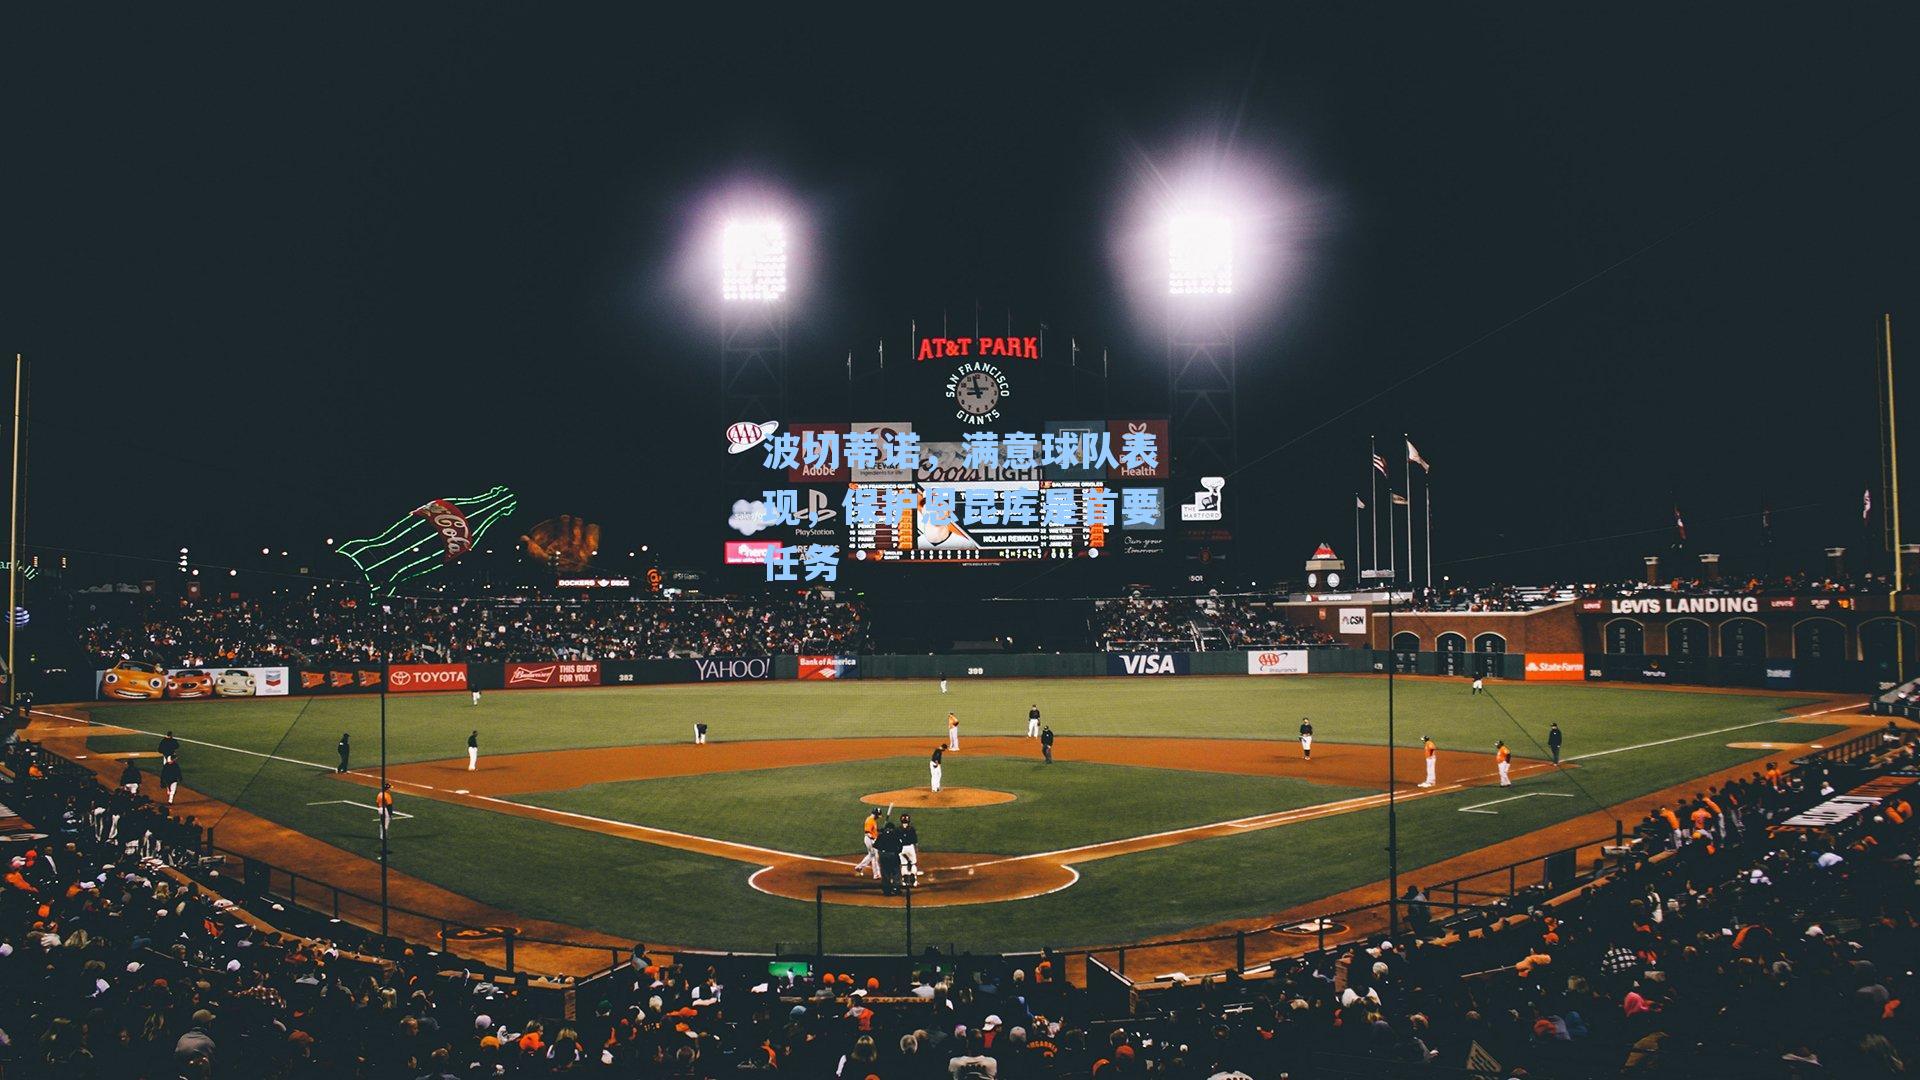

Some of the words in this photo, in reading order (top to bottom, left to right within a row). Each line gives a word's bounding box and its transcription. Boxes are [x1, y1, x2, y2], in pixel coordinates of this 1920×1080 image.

[917, 338, 973, 360] AT&T
[979, 337, 1038, 359] PARK
[945, 374, 960, 398] SAN
[958, 361, 1010, 397] FRANCISCO
[956, 410, 1001, 425] GIANTS
[1121, 466, 1157, 476] Health
[795, 528, 835, 537] PlayStation
[983, 535, 1007, 543] NOLAN
[1008, 535, 1039, 543] REIMOLD
[1665, 597, 1759, 613] LANDING
[1350, 616, 1364, 625] CSN
[800, 657, 818, 666] Bank
[819, 657, 827, 666] of
[827, 658, 857, 666] America
[1119, 654, 1175, 674] VISA
[1538, 662, 1561, 671] State
[1562, 662, 1584, 671] Farm
[560, 665, 576, 673] THIS
[577, 664, 598, 673] BUD'S
[696, 658, 771, 681] YAHOO!
[413, 671, 466, 683] TOYOTA
[515, 669, 552, 679] Budweiser
[560, 674, 573, 682] FOR
